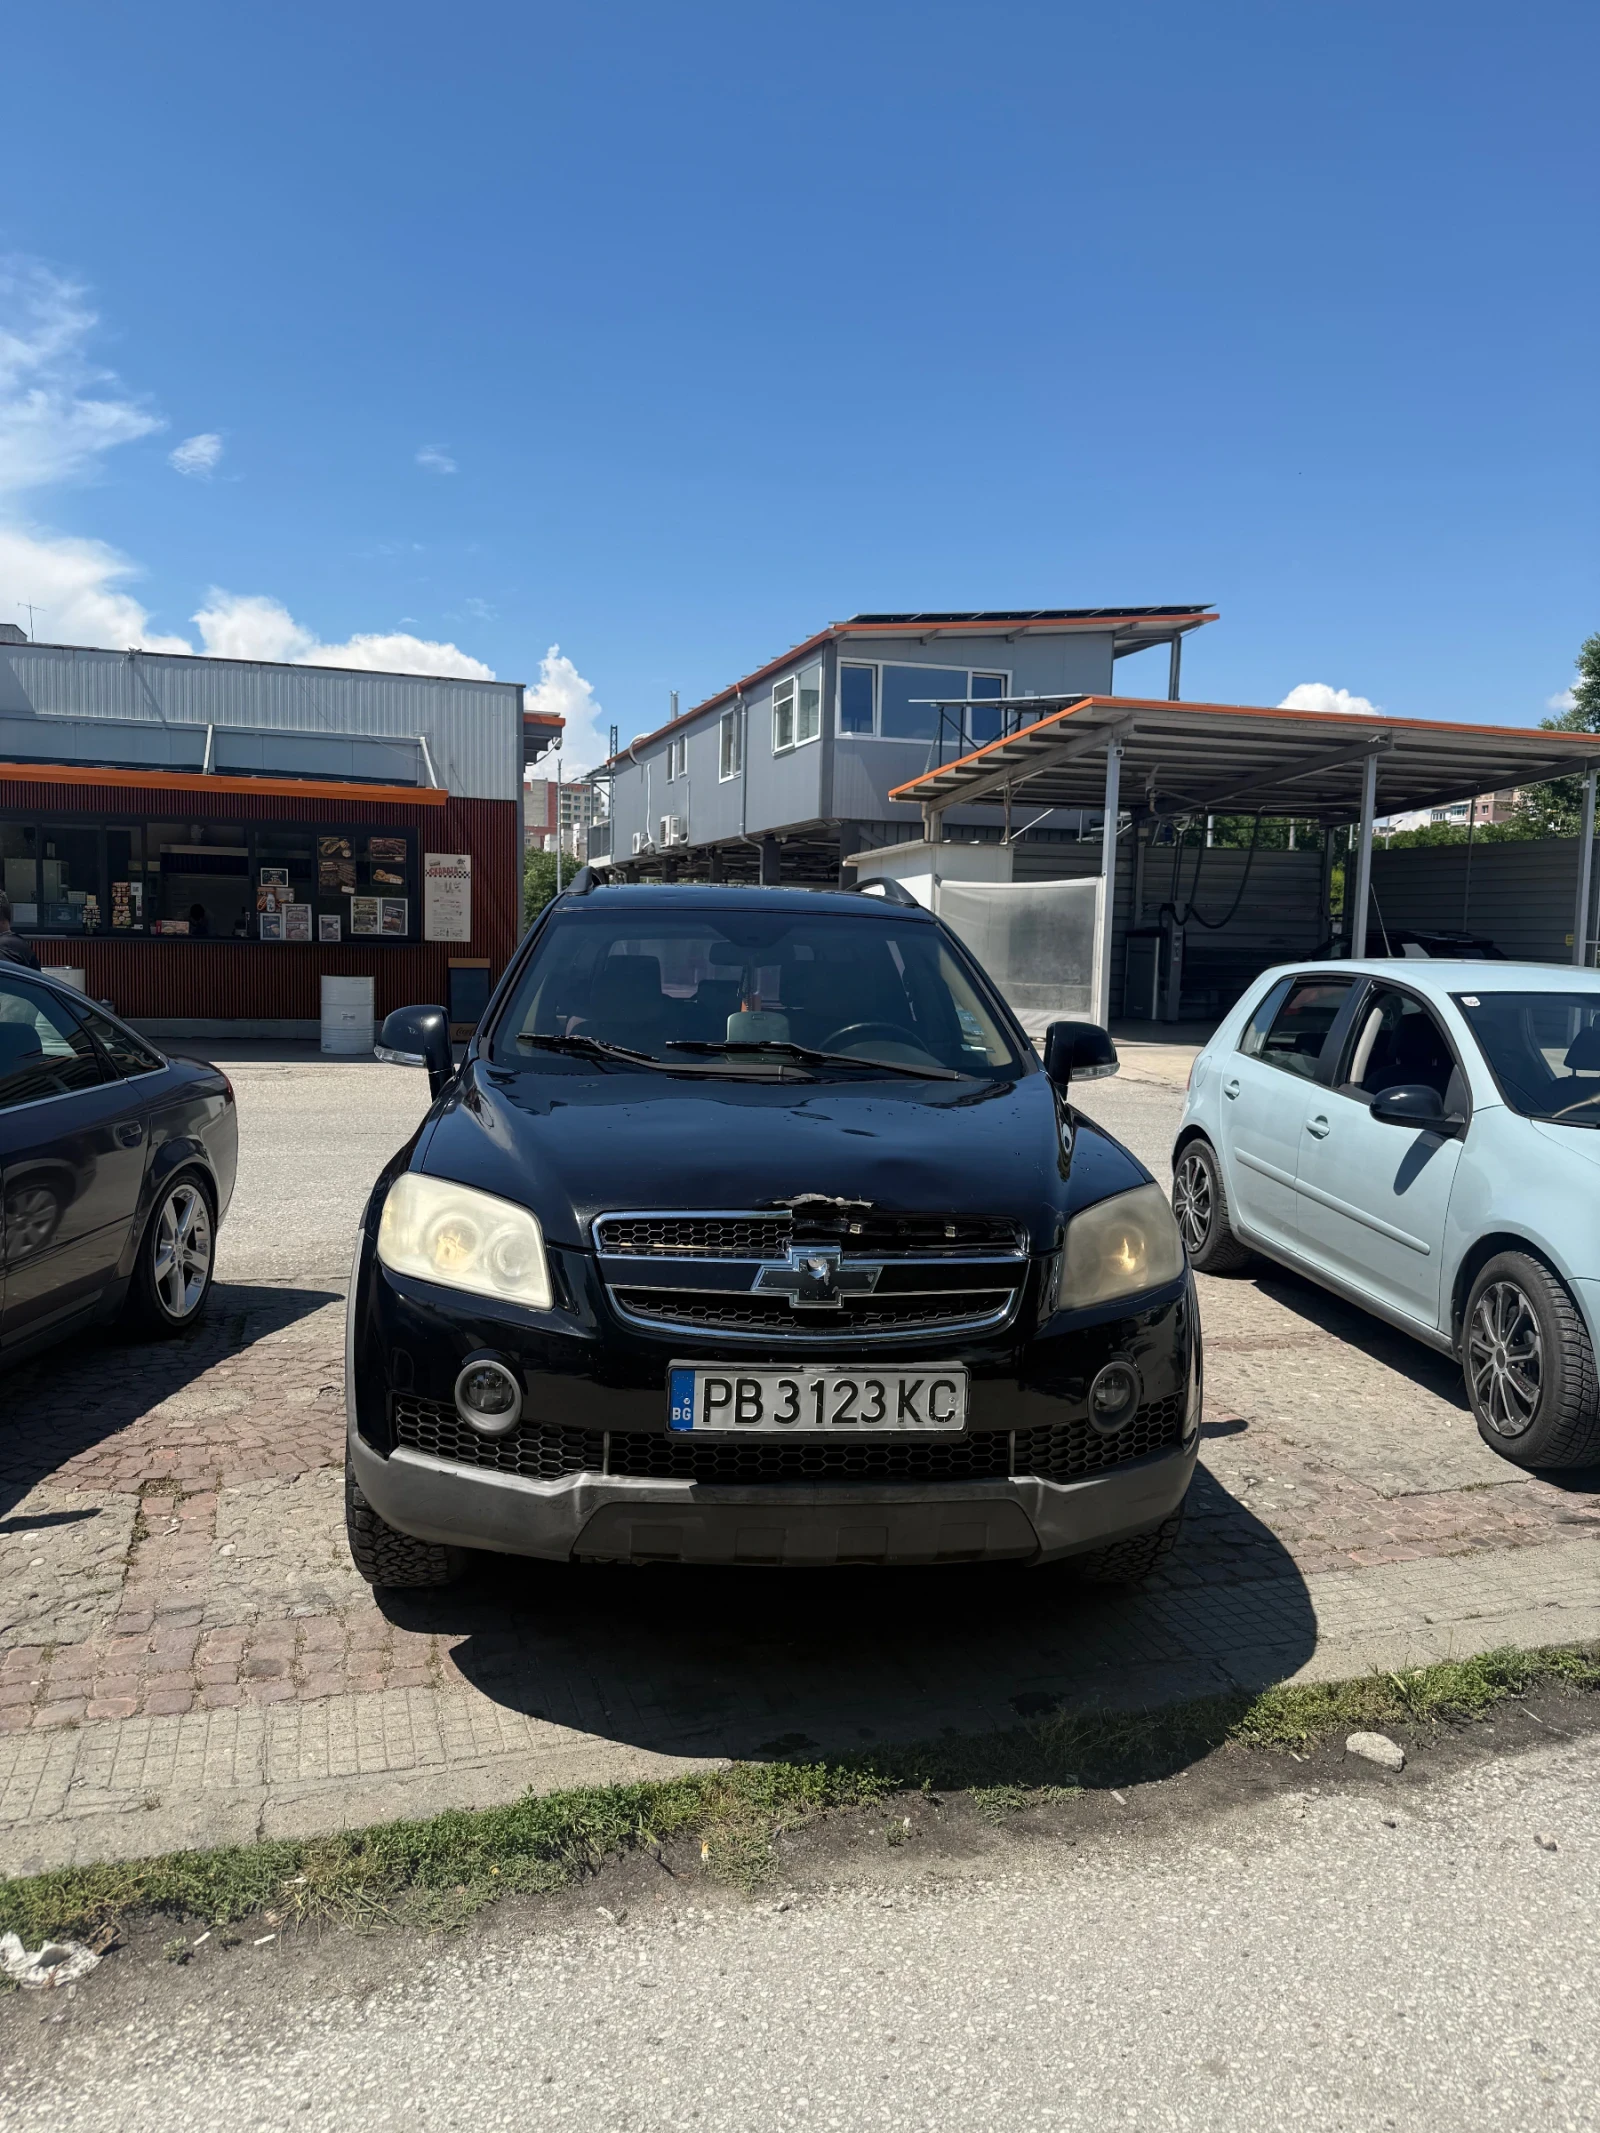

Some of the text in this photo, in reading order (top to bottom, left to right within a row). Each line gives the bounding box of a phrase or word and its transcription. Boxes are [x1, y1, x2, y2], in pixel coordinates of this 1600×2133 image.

[672, 1407, 692, 1421] BG
[703, 1378, 957, 1424] PB 3123 KC
